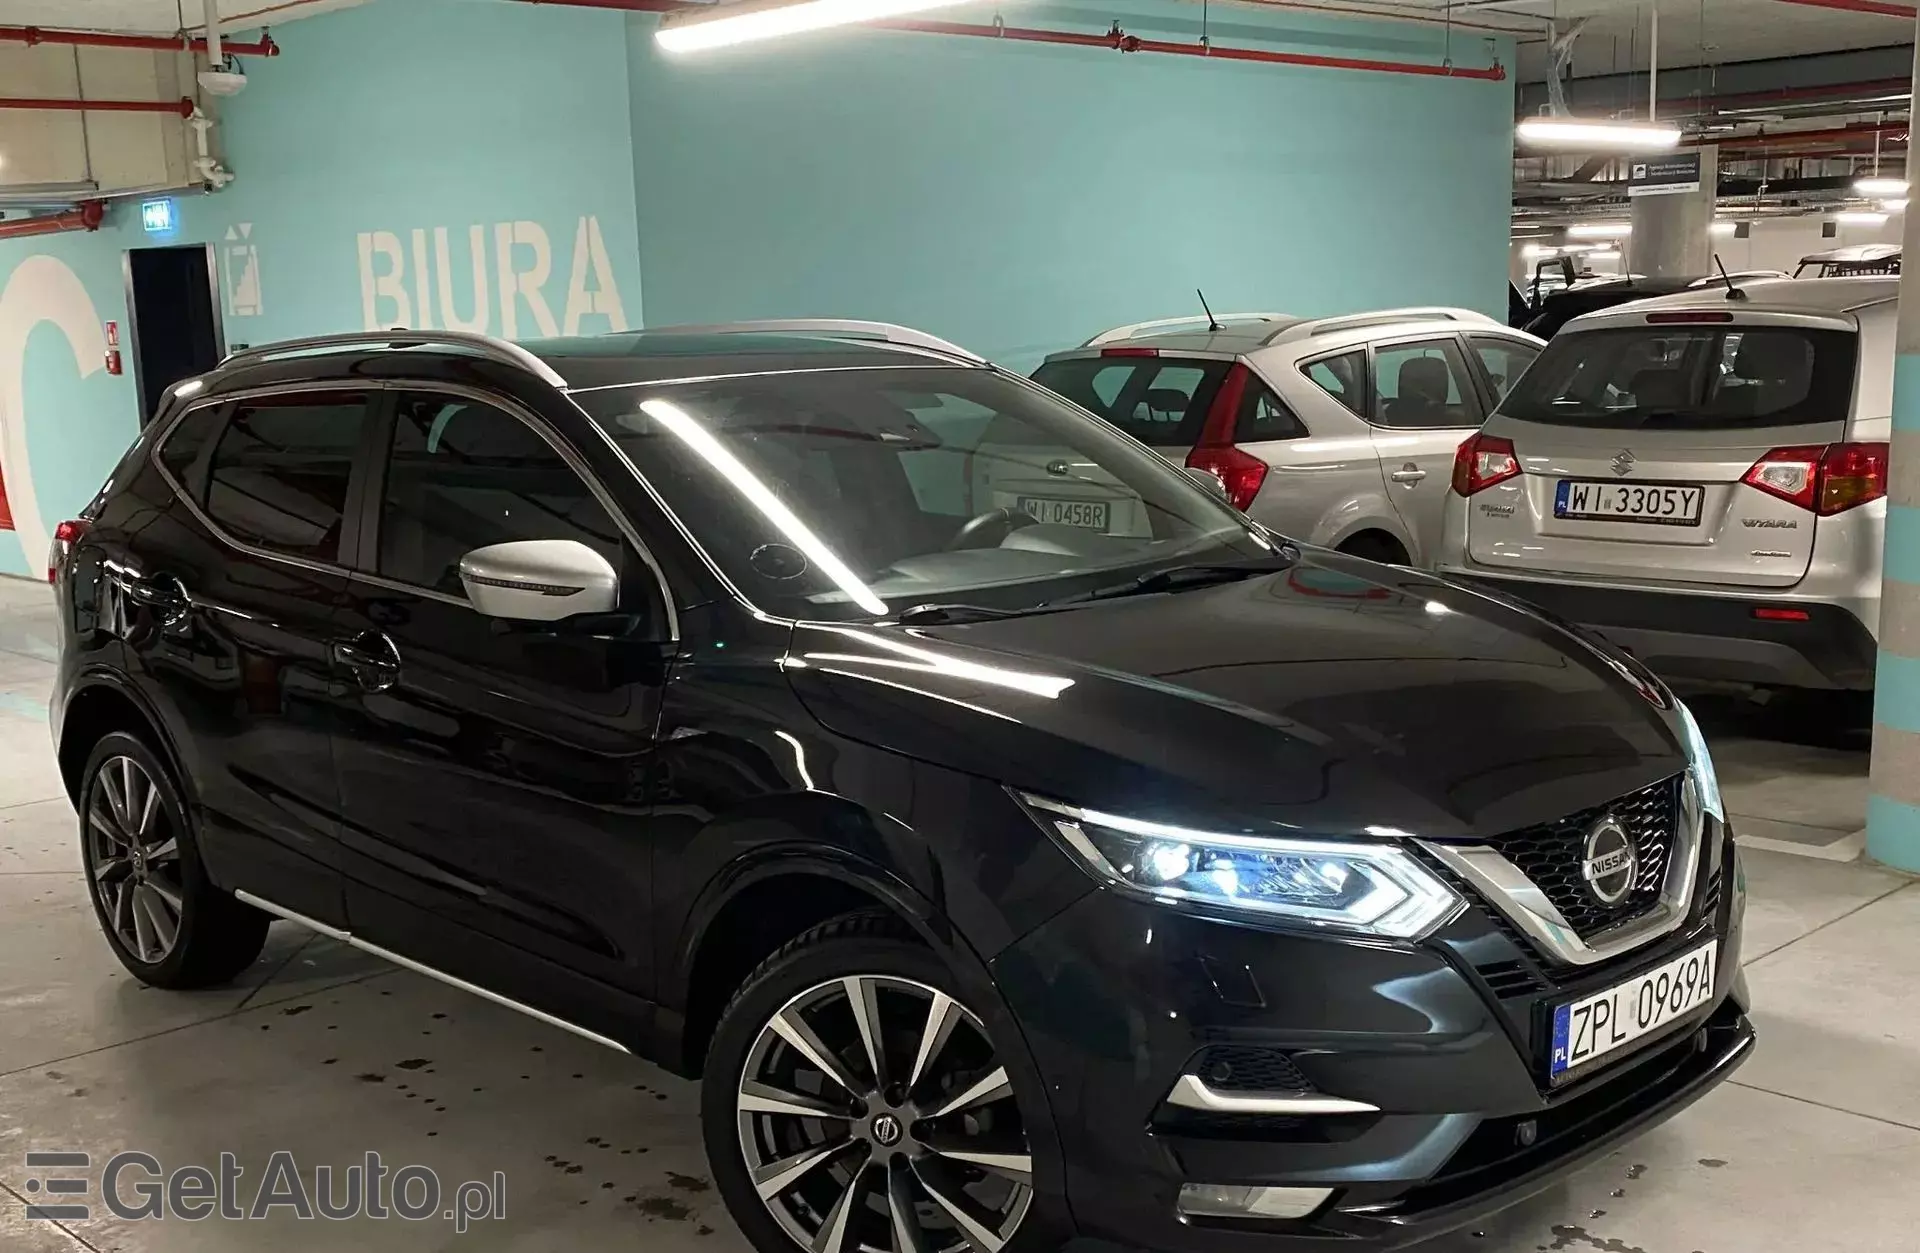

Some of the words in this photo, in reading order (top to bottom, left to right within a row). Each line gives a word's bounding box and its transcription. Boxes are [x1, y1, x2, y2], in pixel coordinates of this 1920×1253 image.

[357, 215, 629, 339] BIURA
[1054, 503, 1104, 529] 0458R
[1572, 485, 1602, 512] WI
[1615, 487, 1696, 517] 3305Y
[1571, 993, 1627, 1063] ZPL
[1638, 950, 1711, 1029] 0969A
[1554, 1047, 1567, 1064] PL
